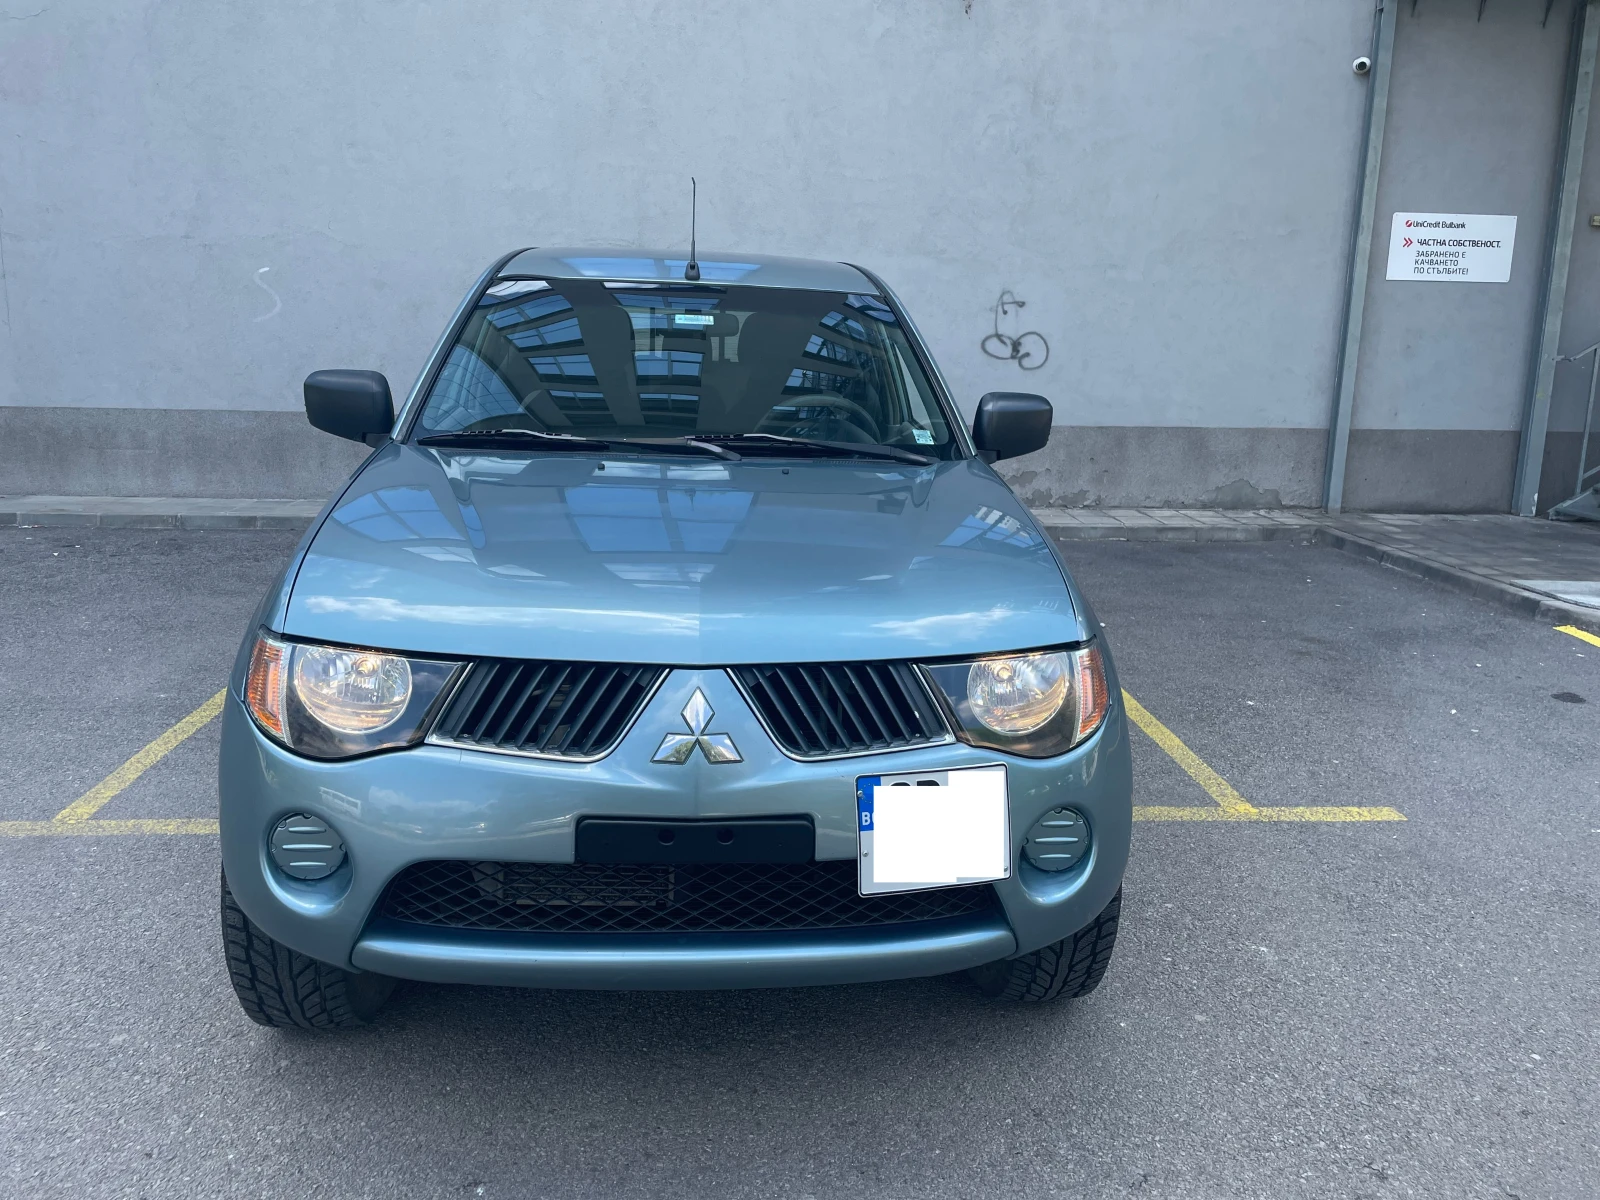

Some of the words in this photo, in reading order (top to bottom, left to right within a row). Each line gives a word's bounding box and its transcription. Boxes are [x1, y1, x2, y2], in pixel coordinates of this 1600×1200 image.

[1412, 220, 1441, 229] UniCredit
[1441, 221, 1466, 229] Bulbank
[1417, 238, 1447, 247] ЧАСТНА
[1447, 239, 1501, 248] СОБСТВЕНОСТ.
[1415, 250, 1460, 259] ЗАБРАНЕНО
[1414, 258, 1459, 267] КАЧВАНЕТО
[1413, 266, 1425, 275] ПО
[1426, 266, 1469, 276] СТЪЛБИТЕ!
[861, 811, 875, 826] B
